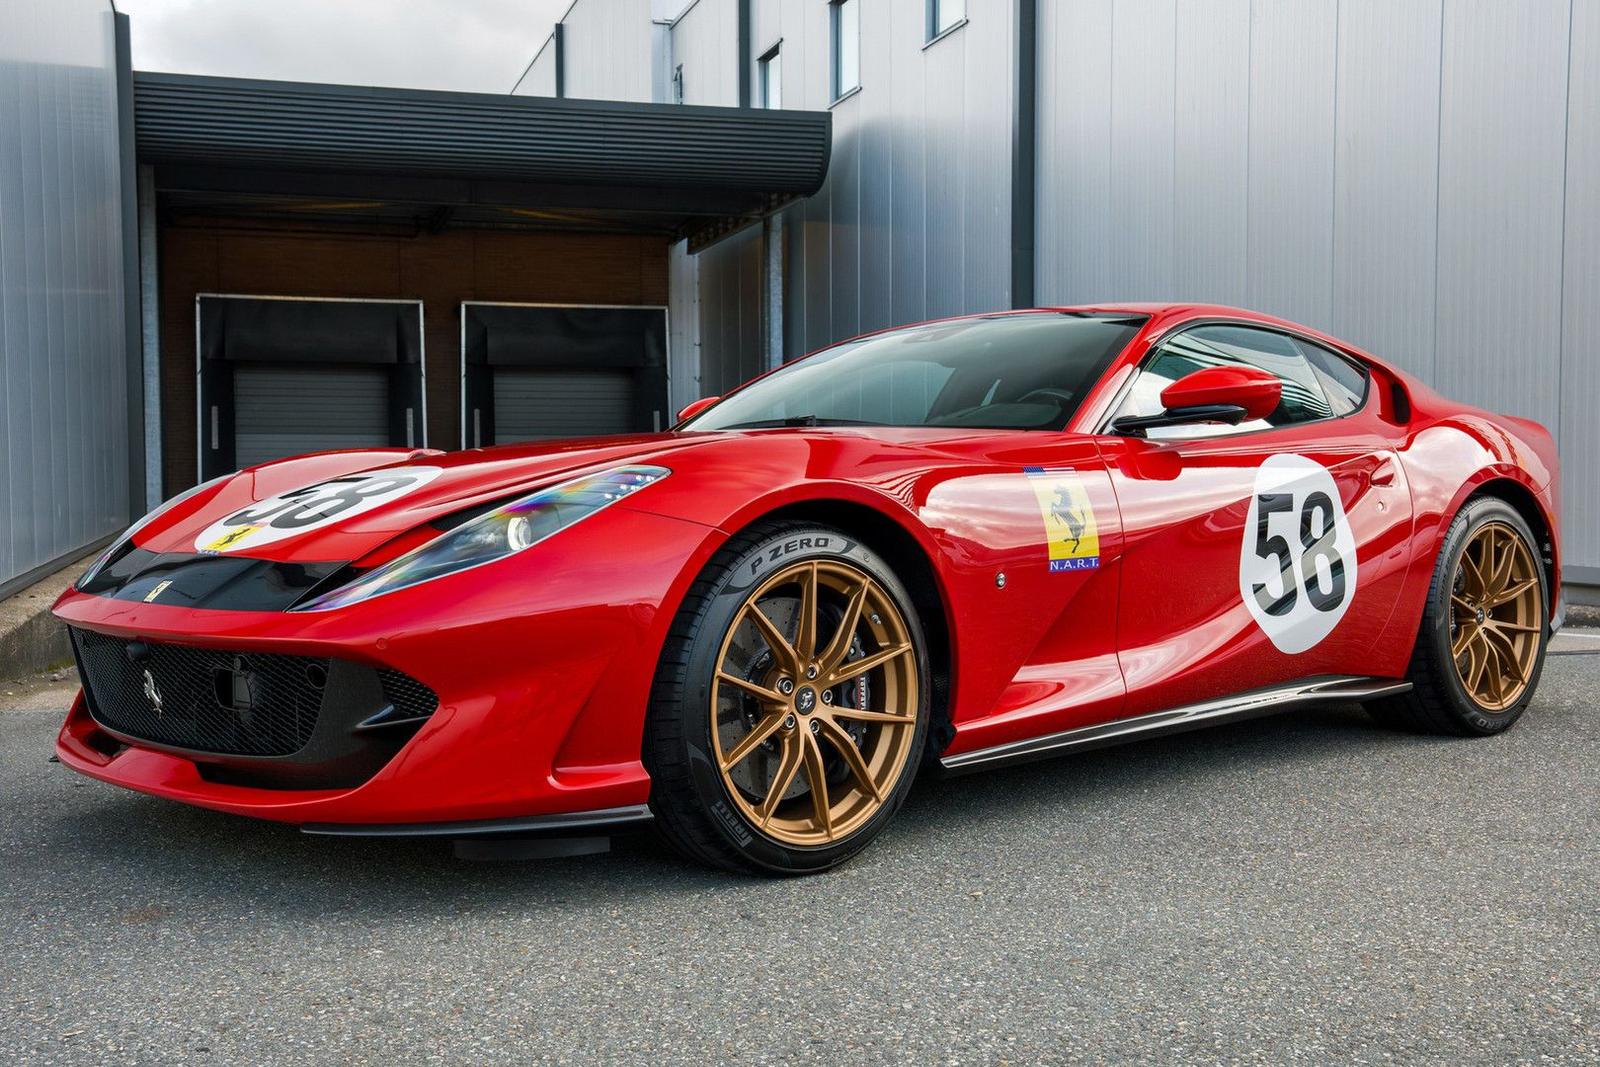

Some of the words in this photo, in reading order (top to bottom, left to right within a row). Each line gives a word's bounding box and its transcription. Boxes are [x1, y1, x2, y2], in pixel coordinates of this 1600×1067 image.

[223, 476, 420, 529] 58
[750, 556, 763, 575] P
[769, 538, 829, 562] ZERO
[1050, 558, 1099, 570] N.A.R.T.
[1253, 491, 1345, 617] 58
